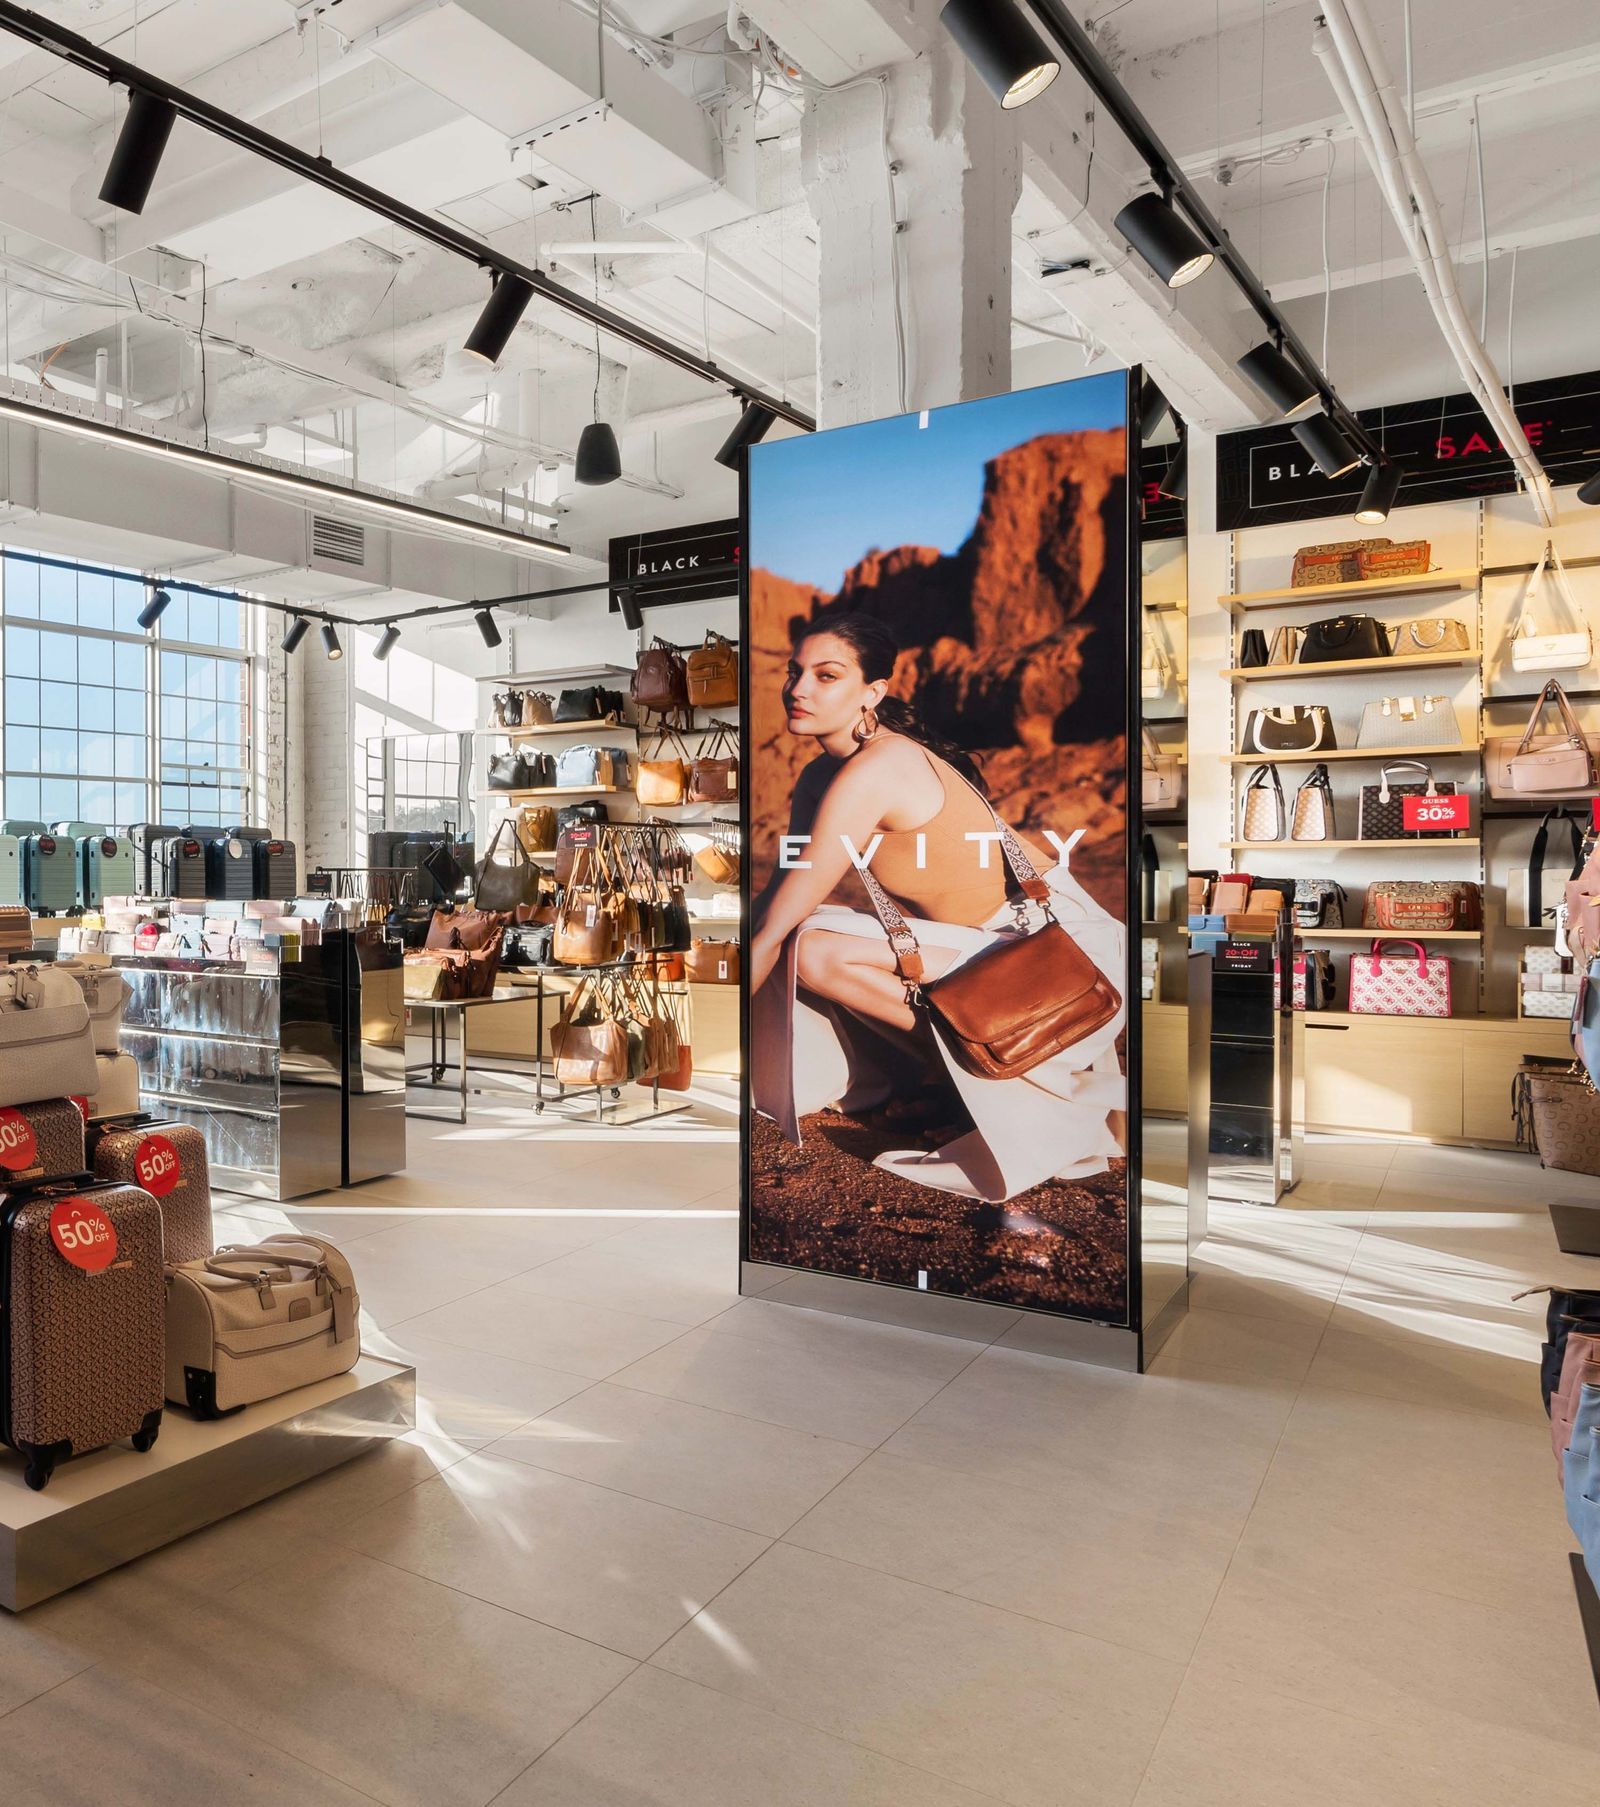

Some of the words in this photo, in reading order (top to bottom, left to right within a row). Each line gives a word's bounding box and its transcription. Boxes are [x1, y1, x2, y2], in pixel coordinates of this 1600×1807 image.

[1269, 453, 1372, 481] BLAK
[637, 555, 699, 576] BLACK
[1417, 807, 1456, 821] 30%
[779, 828, 1087, 869] EVITY
[17, 1132, 30, 1143] OFF
[140, 1149, 173, 1181] 50%
[165, 1160, 176, 1171] OFF
[57, 1218, 106, 1249] 50%
[94, 1232, 110, 1242] OFF
